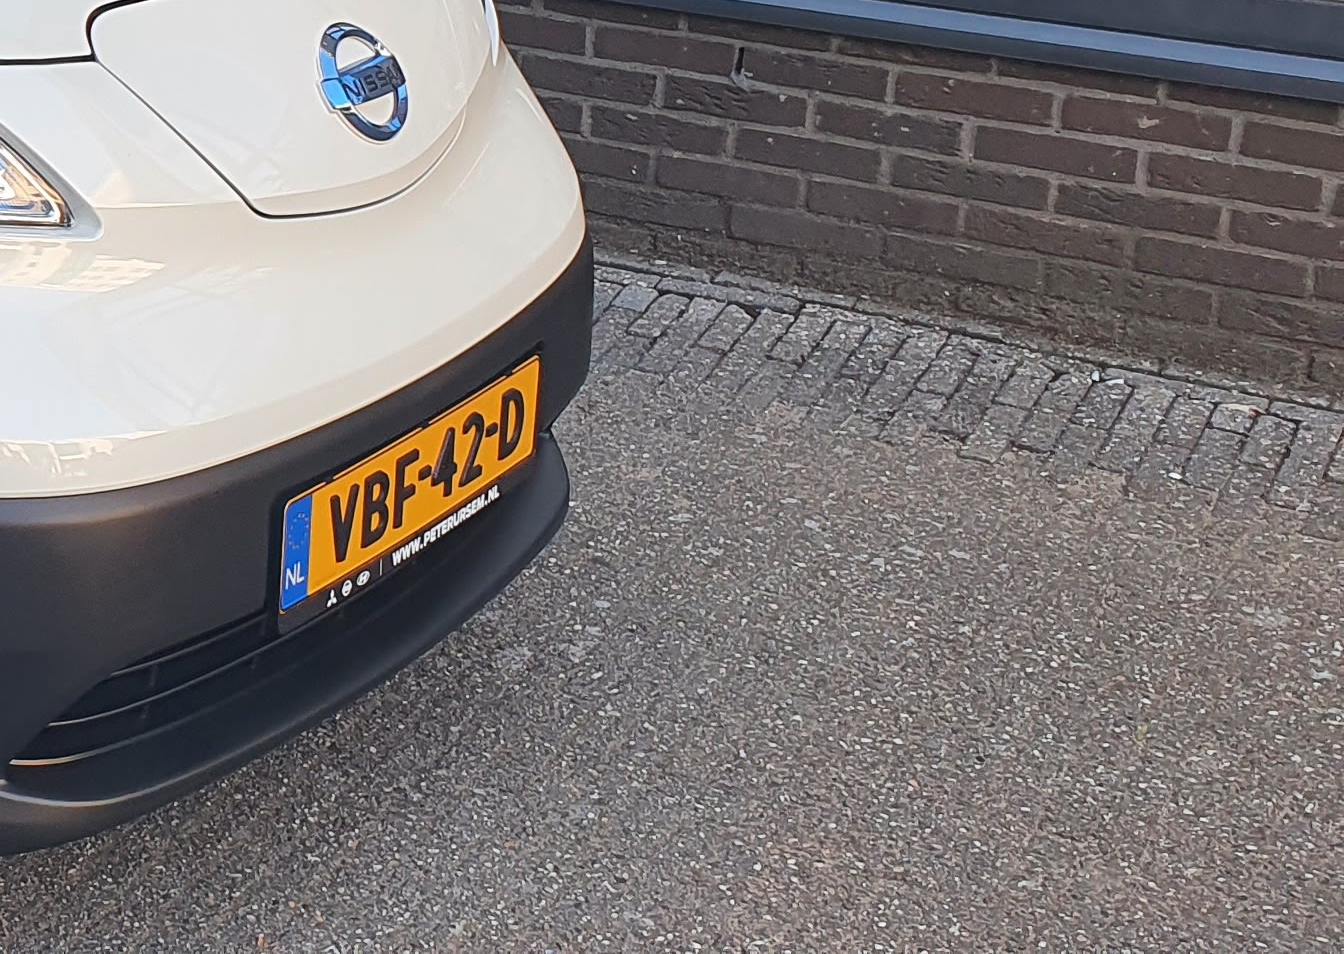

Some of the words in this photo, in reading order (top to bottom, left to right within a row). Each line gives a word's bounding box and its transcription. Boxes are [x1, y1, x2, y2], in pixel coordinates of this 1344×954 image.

[330, 387, 525, 564] VBF-42-D
[392, 485, 500, 566] WWW.PETERURSEM.NL
[285, 562, 306, 589] NL
